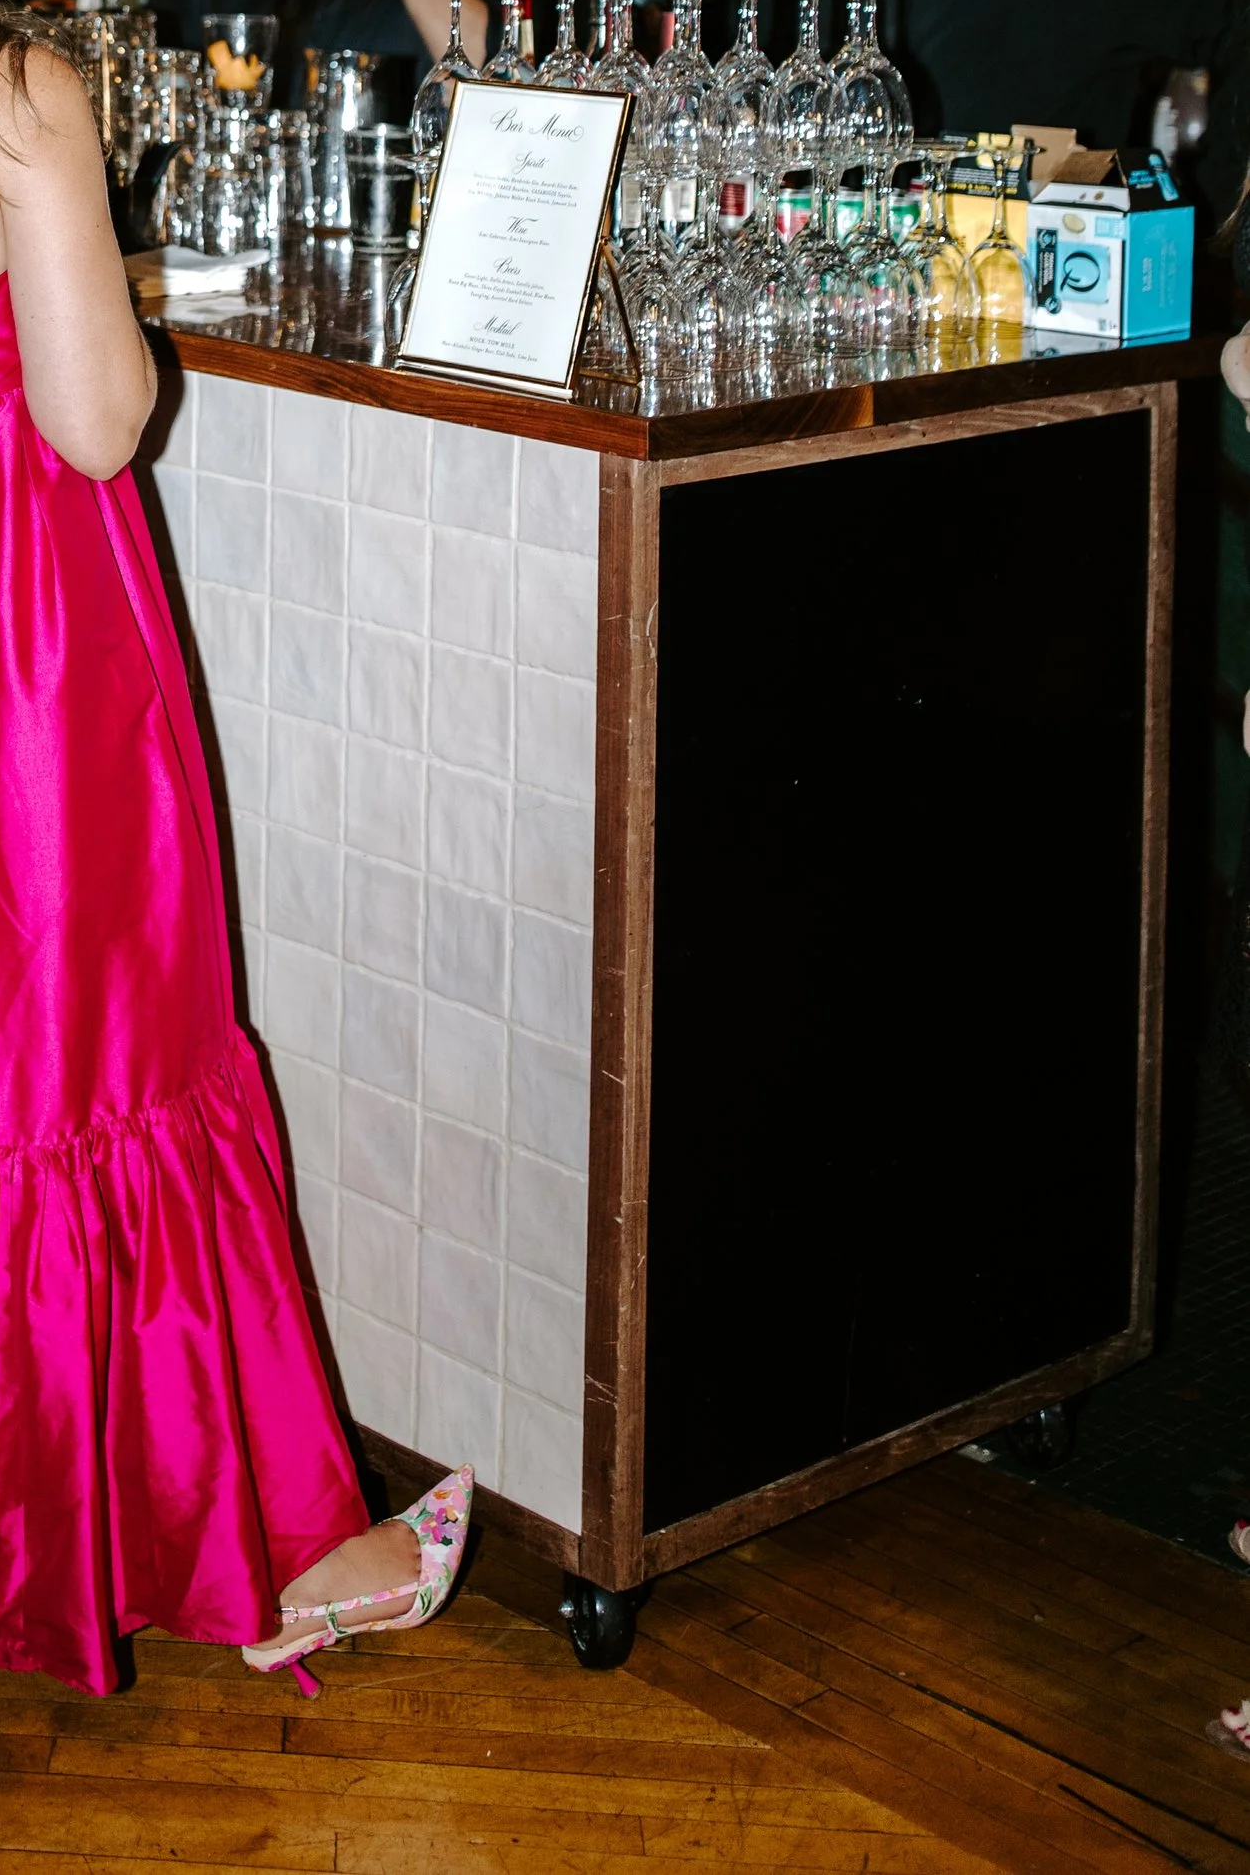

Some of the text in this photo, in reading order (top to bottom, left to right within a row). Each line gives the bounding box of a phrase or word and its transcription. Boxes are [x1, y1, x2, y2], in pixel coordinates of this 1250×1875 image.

[490, 107, 584, 142] Bar Menu
[513, 150, 549, 174] Spirits
[506, 215, 538, 234] Wine
[493, 256, 521, 275] Beers
[1060, 252, 1101, 293] Q
[473, 315, 521, 335] Mocktail
